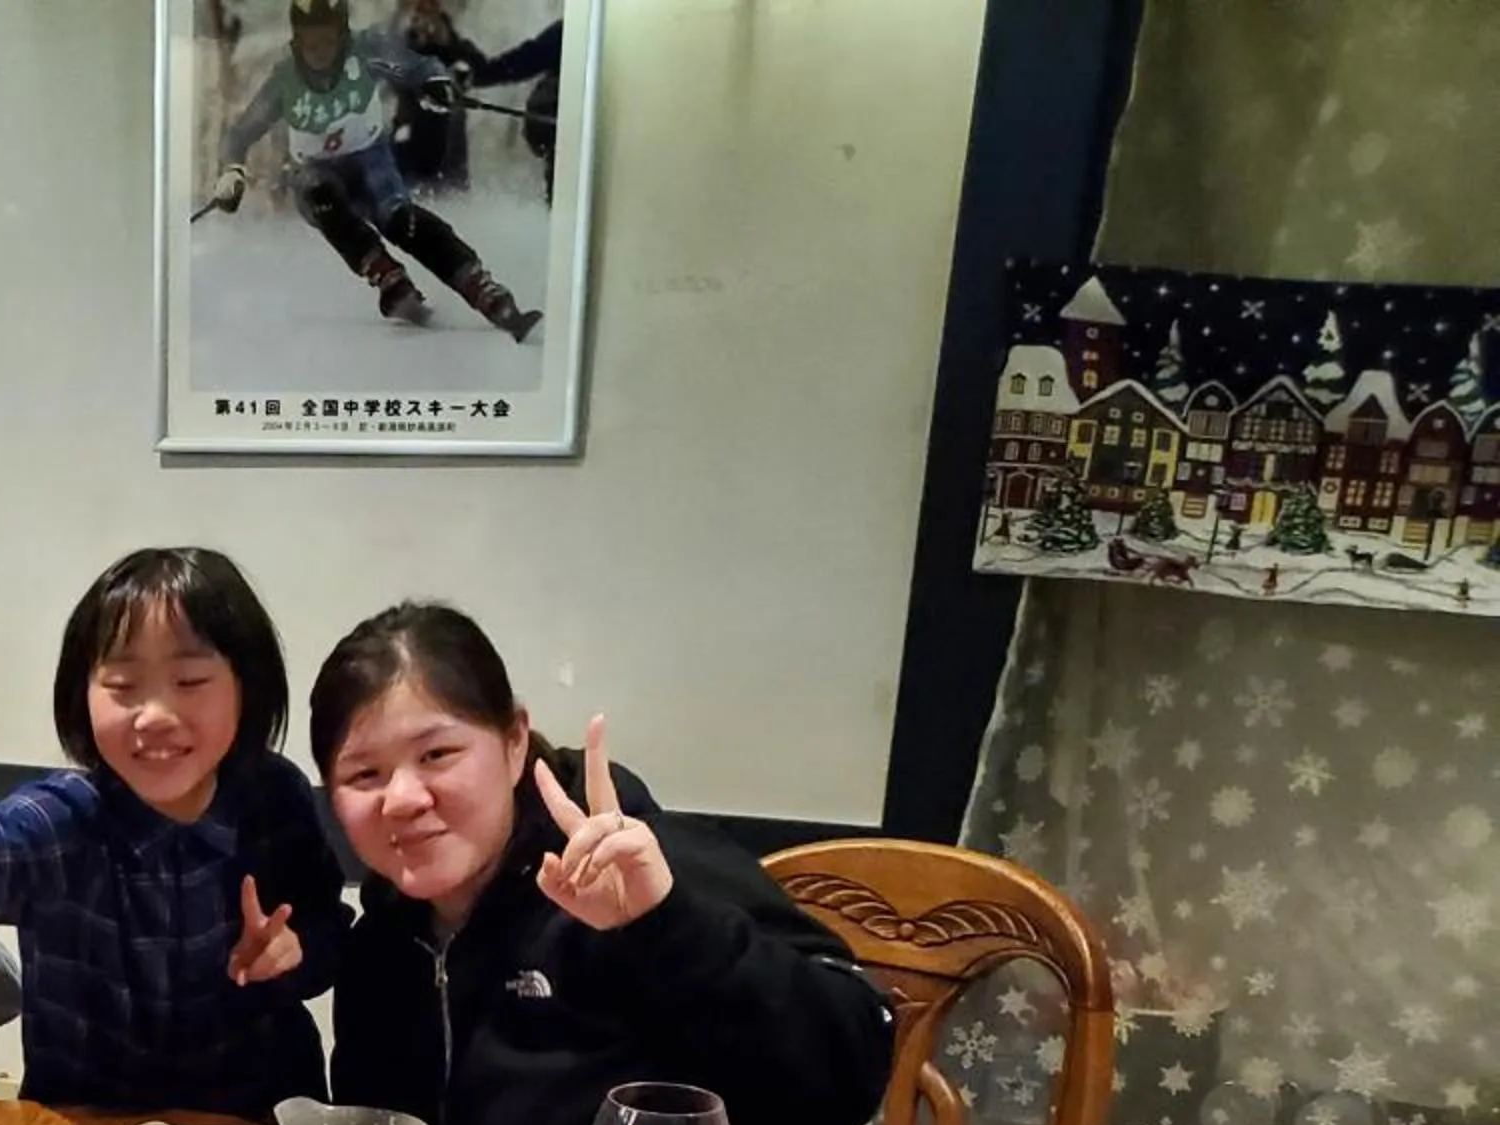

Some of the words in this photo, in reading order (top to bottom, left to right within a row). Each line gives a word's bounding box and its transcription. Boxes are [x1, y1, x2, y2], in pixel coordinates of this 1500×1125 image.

[214, 399, 281, 416] 第41回
[301, 398, 512, 418] 全国中学校スキー大会
